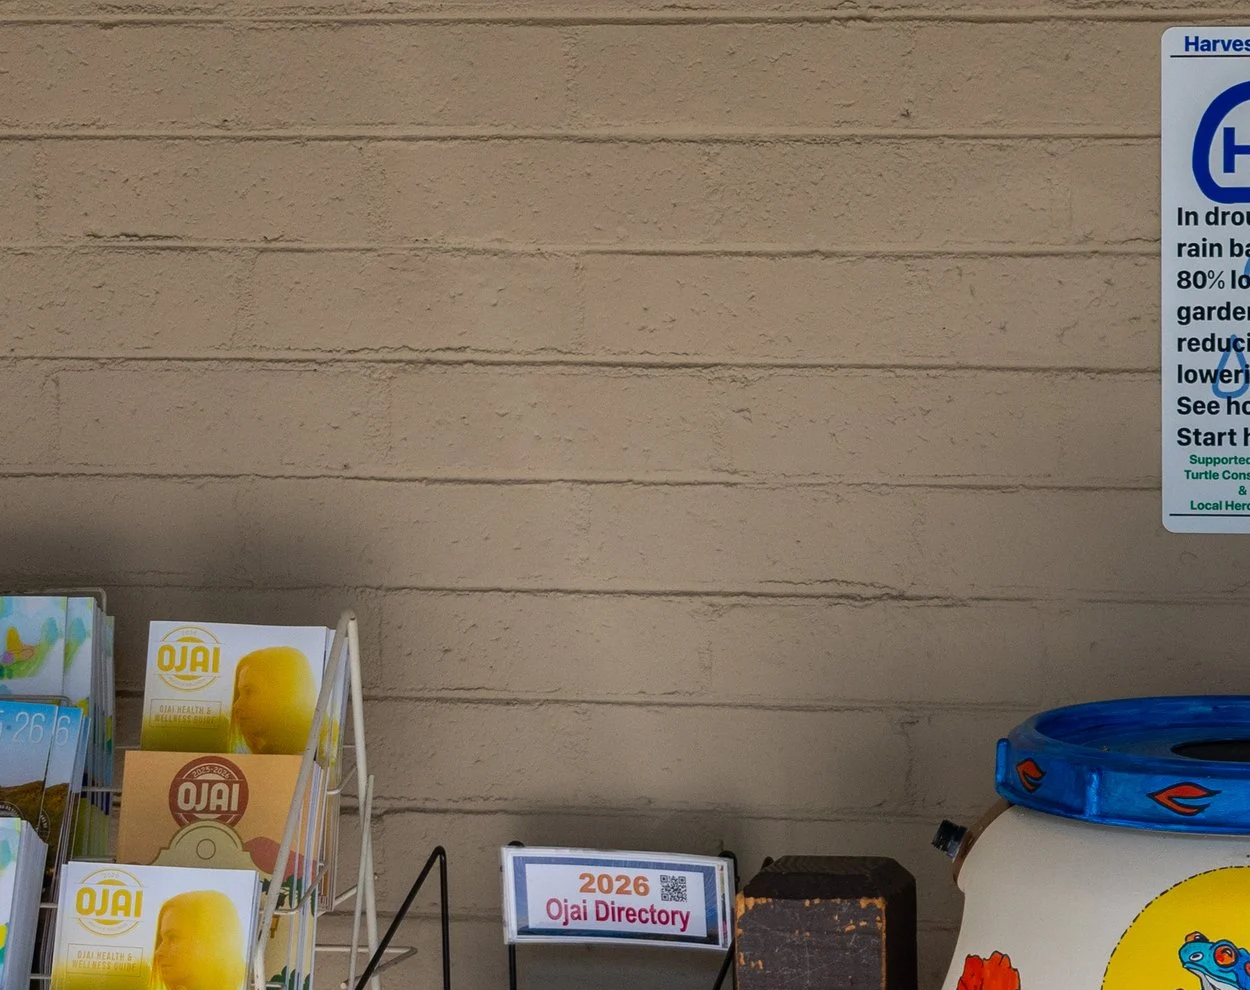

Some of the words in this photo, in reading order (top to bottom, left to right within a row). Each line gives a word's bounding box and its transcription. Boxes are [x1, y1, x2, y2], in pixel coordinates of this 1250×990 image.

[1176, 207, 1199, 226] In
[1176, 239, 1223, 258] rain
[1177, 270, 1225, 289] 80%
[1176, 396, 1220, 416] See
[1176, 427, 1237, 447] Start
[1184, 470, 1220, 481] Turtle
[1238, 485, 1248, 497] &
[1190, 500, 1223, 512] Local
[157, 644, 221, 673] OJAI
[192, 766, 230, 779] 2025-2026
[177, 781, 240, 811] OJAI
[578, 872, 651, 897] 2026
[75, 887, 143, 917] OJAI
[546, 897, 588, 926] Ojai
[595, 900, 691, 932] Directory
